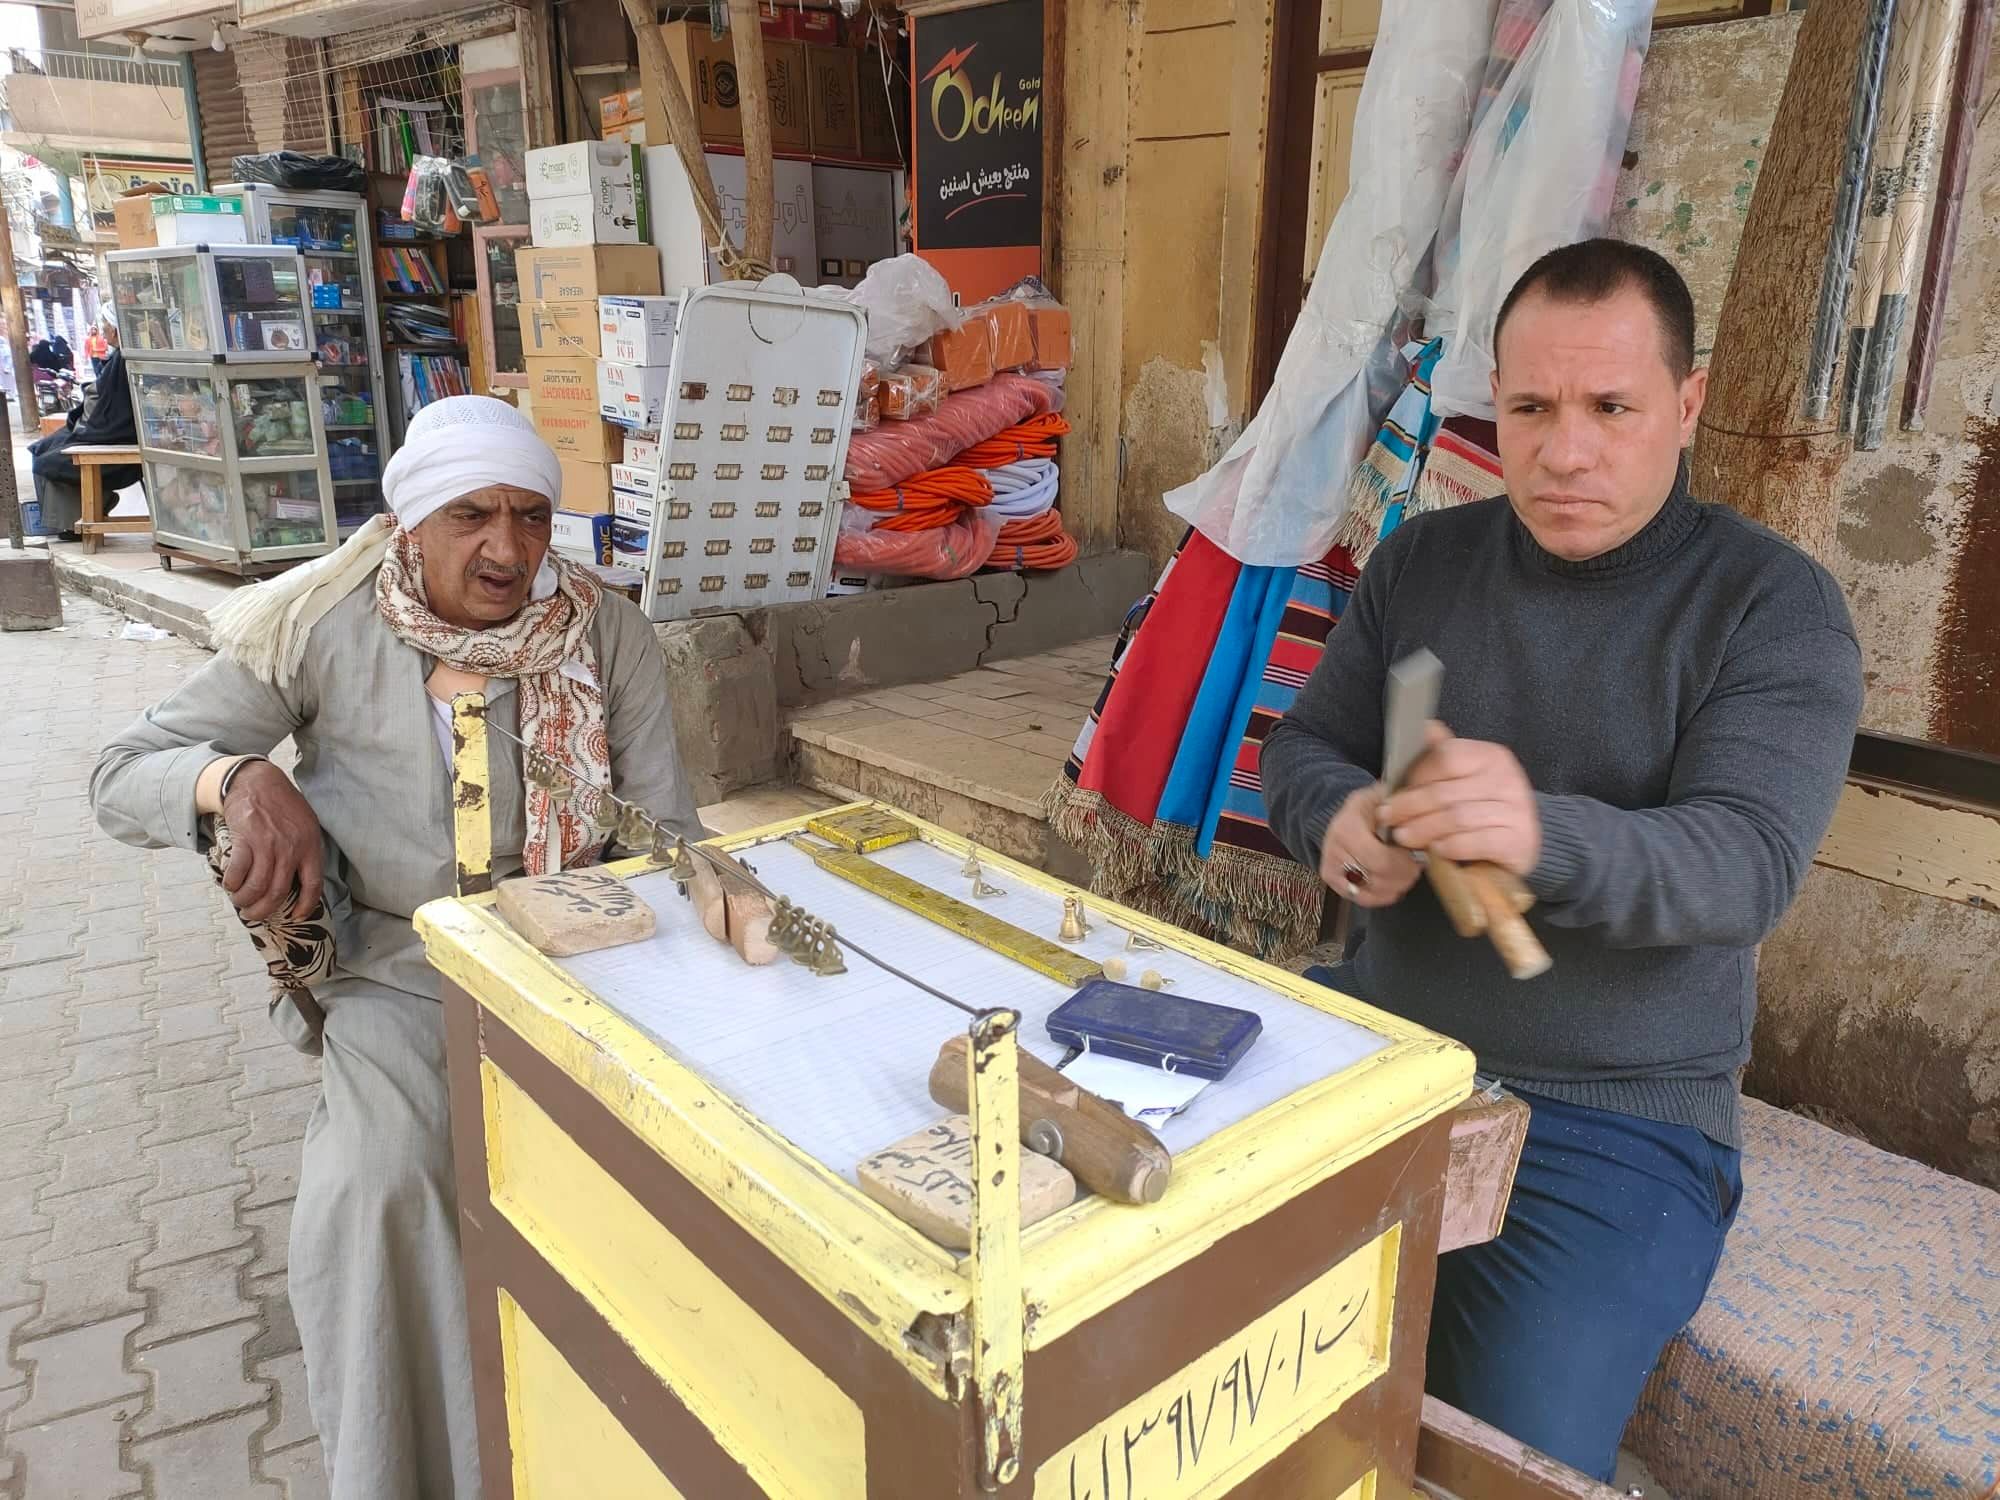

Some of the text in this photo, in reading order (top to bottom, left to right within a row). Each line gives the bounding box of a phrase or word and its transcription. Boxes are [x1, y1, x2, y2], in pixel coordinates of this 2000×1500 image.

[1018, 77, 1041, 90] Gold
[939, 163, 1030, 200] منتج يعيش لسنين
